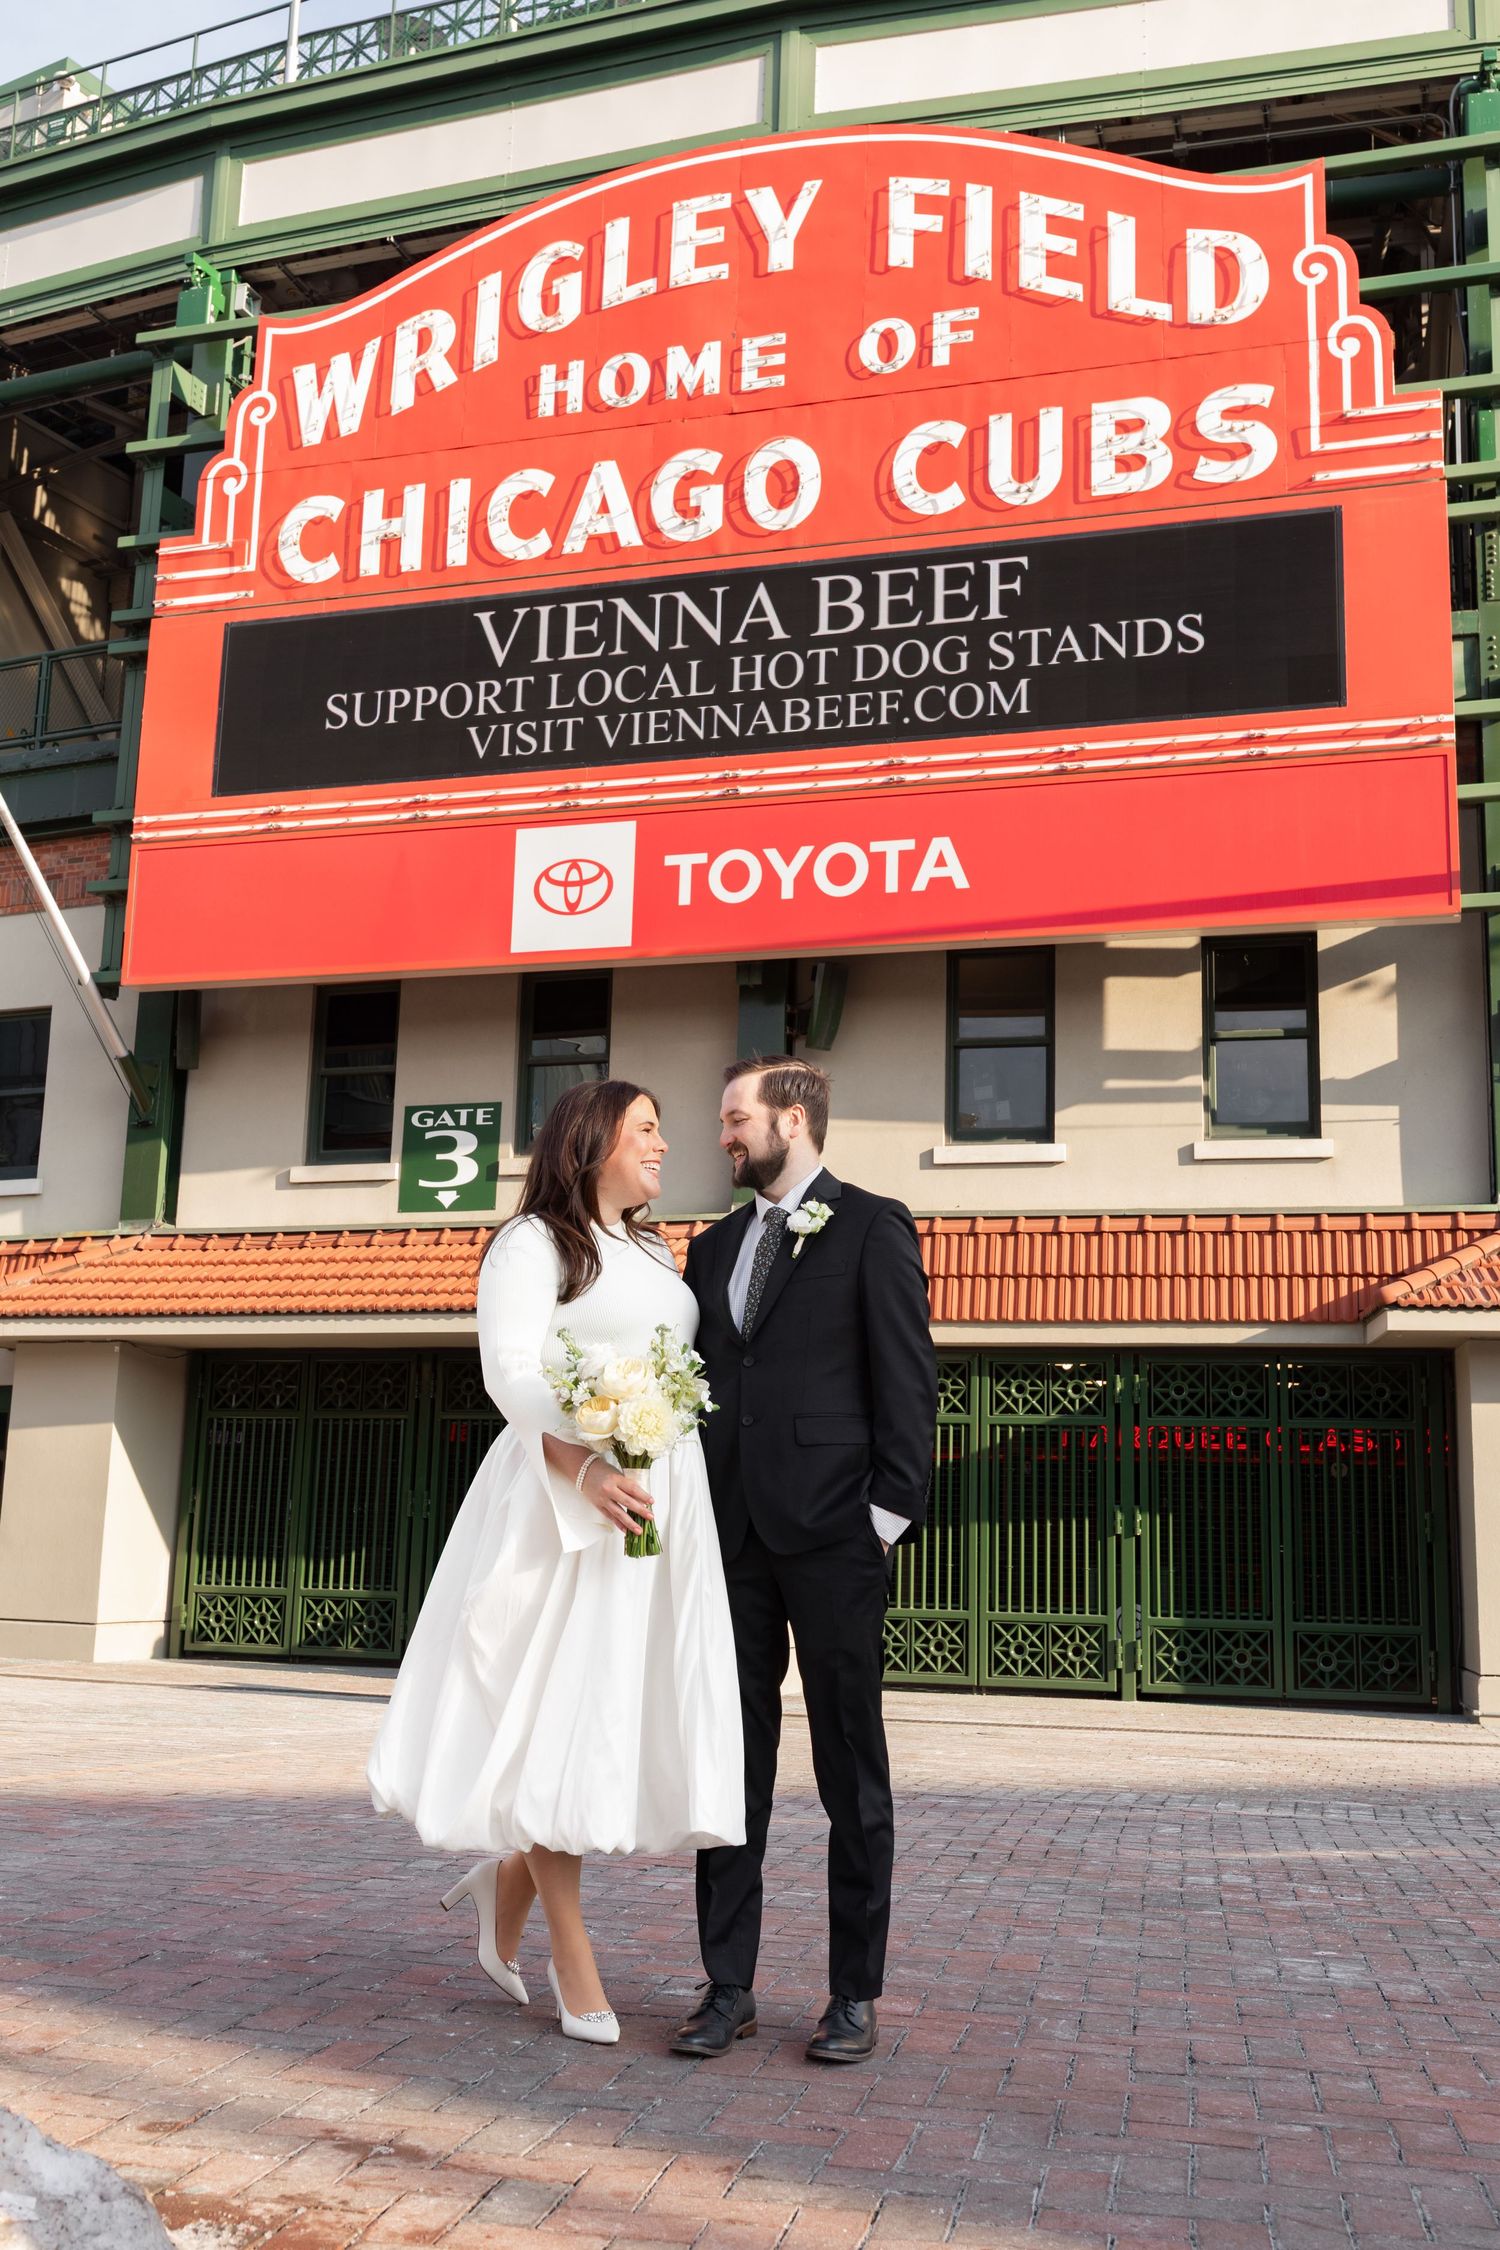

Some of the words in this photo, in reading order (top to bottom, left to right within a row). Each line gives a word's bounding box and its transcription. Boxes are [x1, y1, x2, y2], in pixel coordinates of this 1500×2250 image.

[291, 178, 824, 448] WRIGLEY
[887, 176, 1270, 325] FIELD
[537, 332, 787, 418] HOME
[859, 306, 981, 374] OF
[277, 436, 822, 584] CHICAGO
[892, 383, 1279, 516] CUBS
[473, 581, 791, 668] VIENNA
[810, 556, 1029, 637] BEEF
[325, 676, 535, 730] SUPPORT
[547, 660, 716, 710] LOCAL
[729, 647, 839, 693] HOT
[853, 635, 970, 682] DOG
[988, 613, 1205, 671] STANDS
[466, 717, 584, 759] VISIT
[596, 678, 1031, 748] VIENNABEEF.COM
[663, 836, 971, 906] TOYOTA
[411, 1107, 494, 1128] GATE
[418, 1129, 479, 1188] 3
